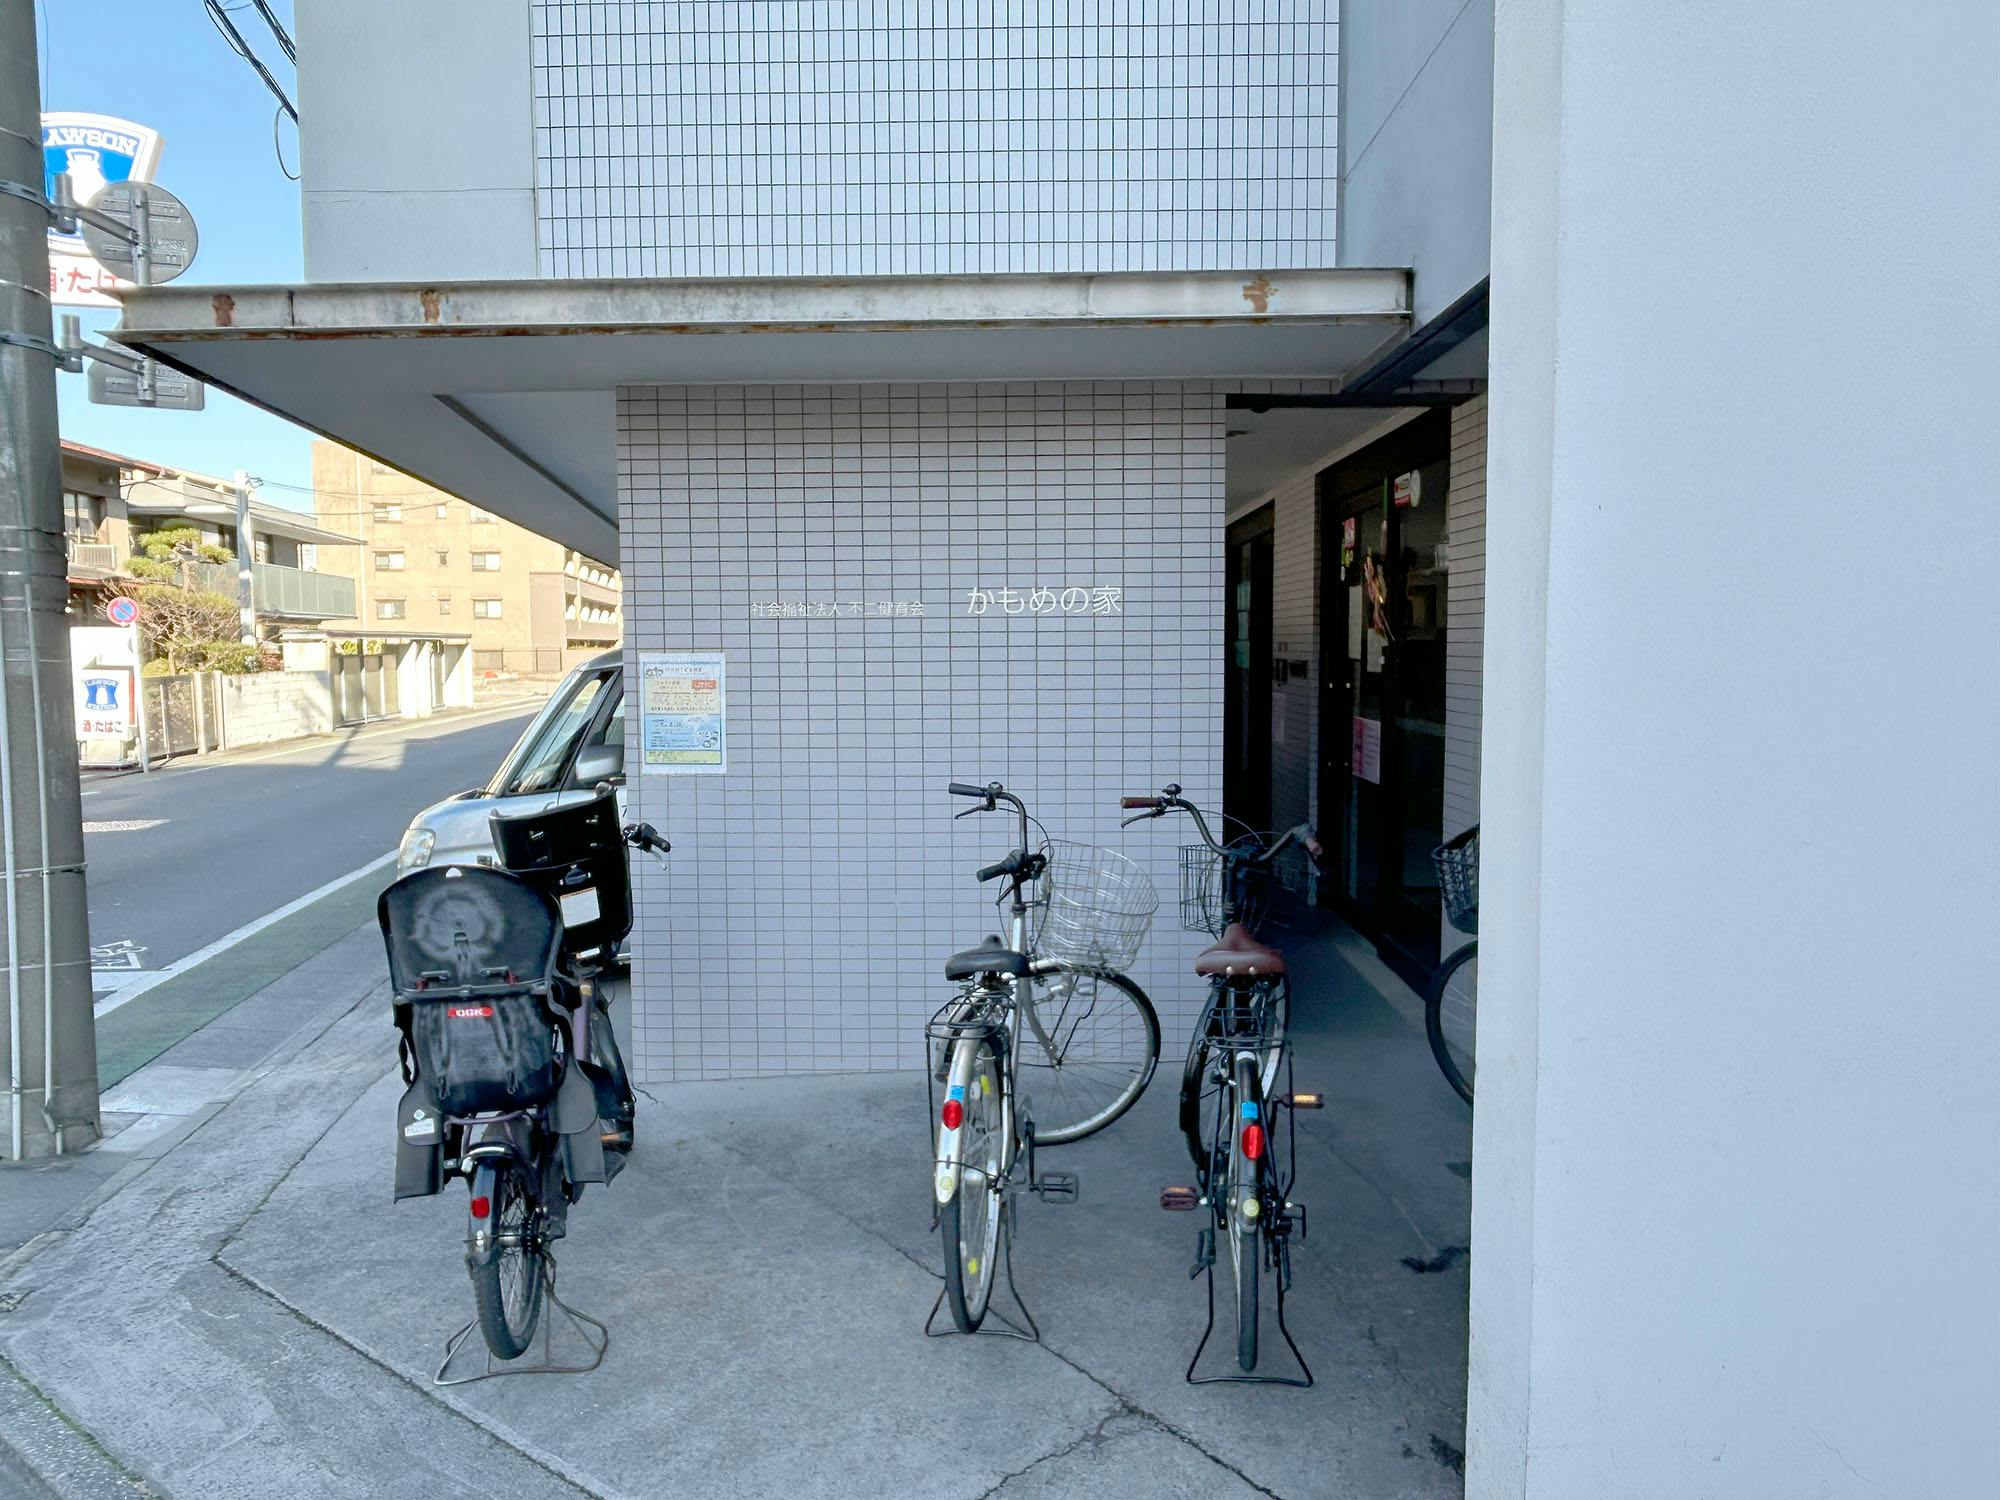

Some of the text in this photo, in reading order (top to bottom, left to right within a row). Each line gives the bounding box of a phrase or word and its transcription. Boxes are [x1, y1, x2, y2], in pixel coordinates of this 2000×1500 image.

[44, 127, 137, 156] AWSON
[751, 601, 843, 617] 社会福祉法人
[967, 585, 1122, 614] かもめの家
